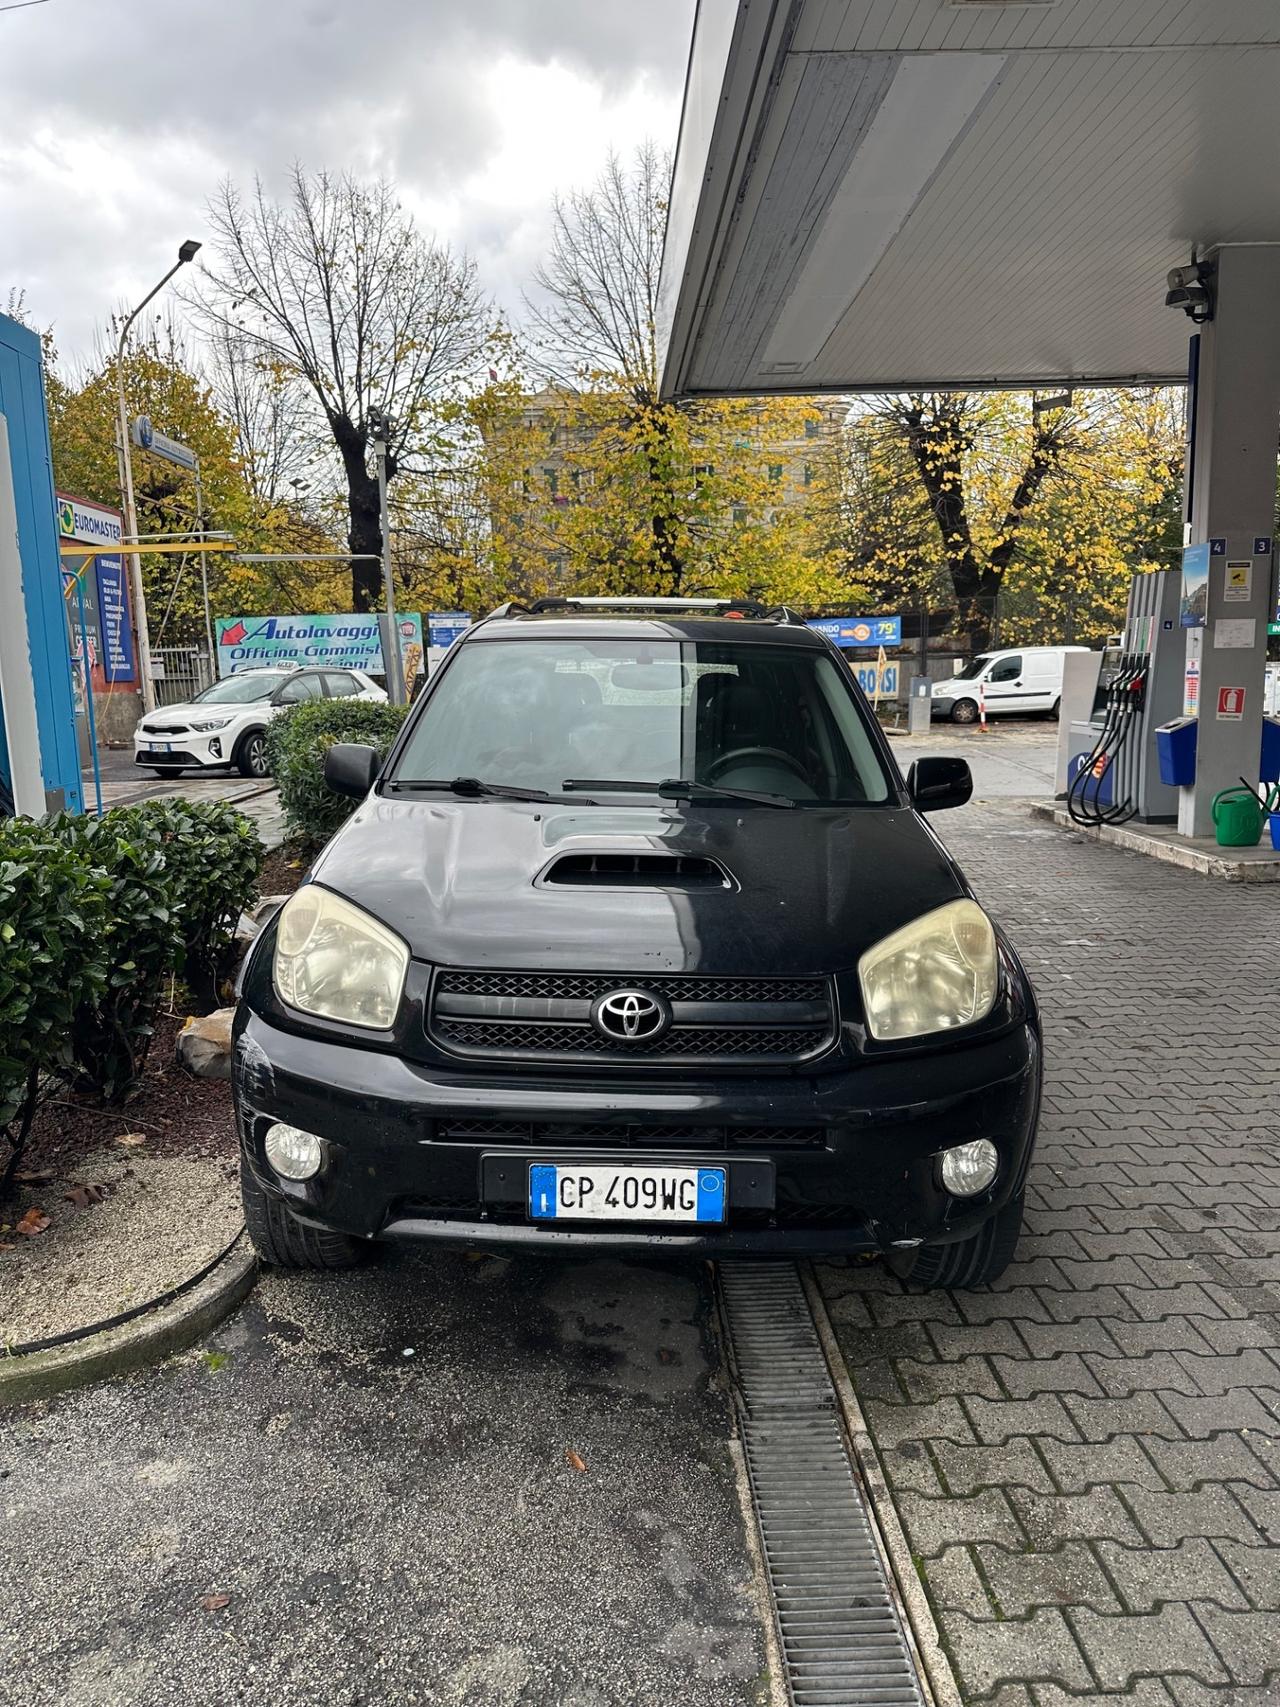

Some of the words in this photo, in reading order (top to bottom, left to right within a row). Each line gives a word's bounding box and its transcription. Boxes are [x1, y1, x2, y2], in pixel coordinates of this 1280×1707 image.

[75, 513, 121, 540] EUROMASTER
[1213, 543, 1221, 552] 4
[1259, 542, 1266, 551] 3
[560, 1176, 594, 1209] CP
[605, 1176, 696, 1211] 409WG
